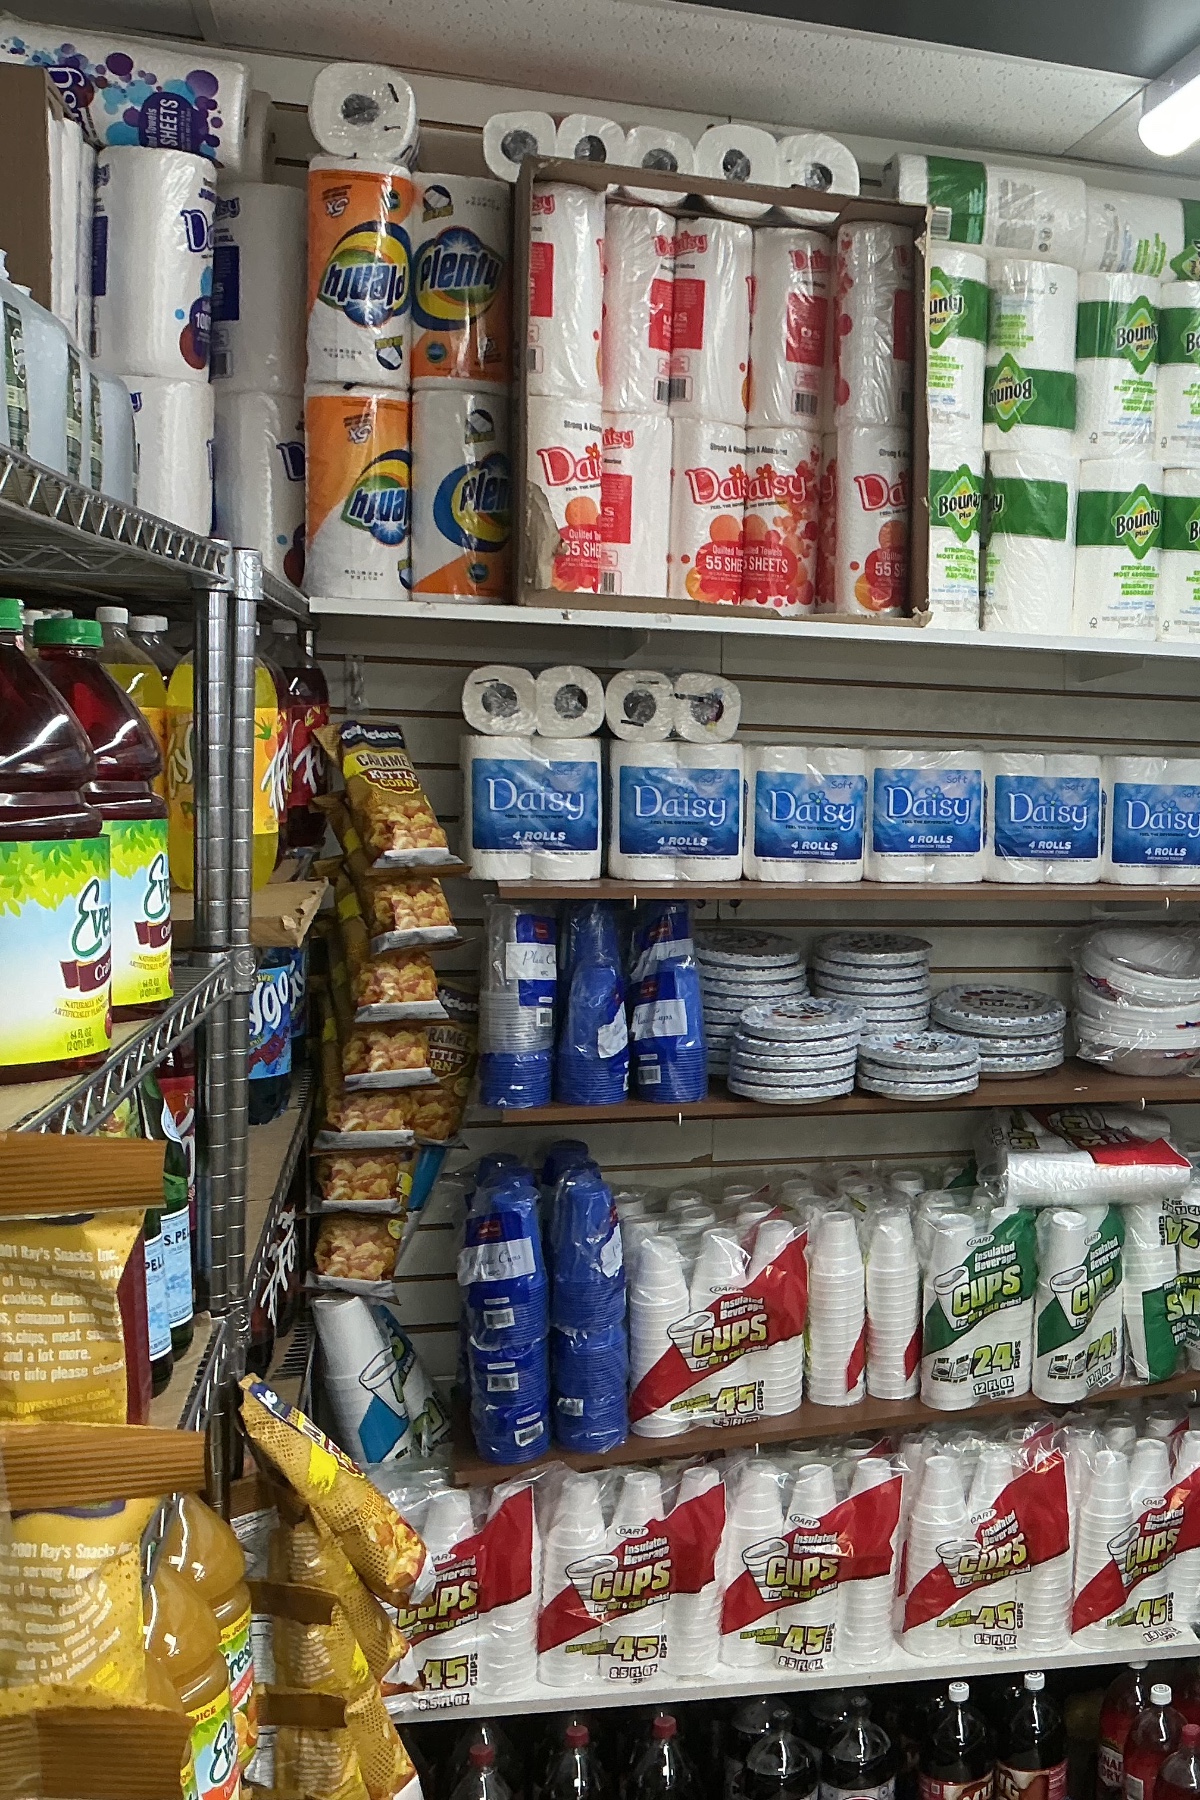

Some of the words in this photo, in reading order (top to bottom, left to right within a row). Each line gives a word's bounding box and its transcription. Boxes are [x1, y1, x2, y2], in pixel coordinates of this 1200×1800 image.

[419, 246, 501, 292] Plenty
[323, 261, 406, 307] Plenty
[1116, 323, 1160, 350] Bounty
[988, 378, 1033, 406] Bounty
[1115, 507, 1161, 538] Bounty
[705, 556, 722, 571] 55
[749, 558, 789, 573] SHEETS
[874, 561, 891, 577] 55
[379, 779, 414, 788] CORN
[487, 778, 585, 822] Daisy
[633, 784, 727, 827] Daisy
[770, 789, 857, 832] Daisy
[886, 786, 971, 826] Daisy
[1009, 792, 1089, 831] Daisy
[513, 831, 522, 842] 4
[525, 830, 566, 842] ROLLS
[657, 836, 667, 847] 4
[668, 836, 708, 847] ROLLS
[791, 840, 800, 850] 4
[801, 841, 839, 852] ROLLS
[908, 835, 917, 844] 4
[918, 834, 953, 844] ROLLS
[1028, 841, 1037, 850] 4
[1039, 840, 1072, 850] ROLLS
[1145, 847, 1153, 856] 4
[1155, 846, 1188, 857] ROLLS
[1165, 1216, 1200, 1248] 24
[54, 1247, 93, 1263] Snacks
[973, 1251, 1017, 1273] Beverage
[974, 1241, 1016, 1263] Insulated
[952, 1264, 1022, 1317] CUPS
[52, 1330, 81, 1343] meat
[692, 1314, 768, 1357] CUPS
[3, 1349, 23, 1362] and
[38, 1349, 54, 1362] lot
[58, 1348, 91, 1361] more.
[972, 1343, 1014, 1379] 24
[1086, 1331, 1113, 1372] 24
[51, 1366, 88, 1383] please
[973, 1383, 986, 1395] 12
[986, 1380, 1000, 1394] FL
[999, 1377, 1014, 1391] OZ
[716, 1384, 757, 1416] 45
[980, 1511, 1017, 1538] Insulated
[1146, 1506, 1184, 1524] Insulated
[619, 1526, 647, 1536] DART
[793, 1531, 838, 1546] Insulated
[982, 1521, 1020, 1548] Beverage
[40, 1542, 71, 1562] Ray's
[75, 1543, 116, 1559] Snacks
[623, 1546, 670, 1566] Beverage
[624, 1537, 668, 1555] Insulated
[958, 1535, 1027, 1574] CUPS
[1126, 1529, 1181, 1572] CUPS
[591, 1560, 671, 1601] CUPS
[765, 1555, 839, 1588] CUPS
[976, 1601, 1017, 1630] 45
[1135, 1593, 1169, 1628] 45
[613, 1635, 659, 1661] 45
[783, 1624, 828, 1655] 45
[973, 1633, 992, 1646] 8.5
[992, 1633, 1003, 1645] FL
[1003, 1633, 1018, 1645] OZ
[425, 1654, 469, 1690] 45
[609, 1666, 629, 1679] 8.5
[630, 1665, 643, 1678] FL
[643, 1664, 658, 1676] OZ
[454, 1692, 470, 1706] OZ
